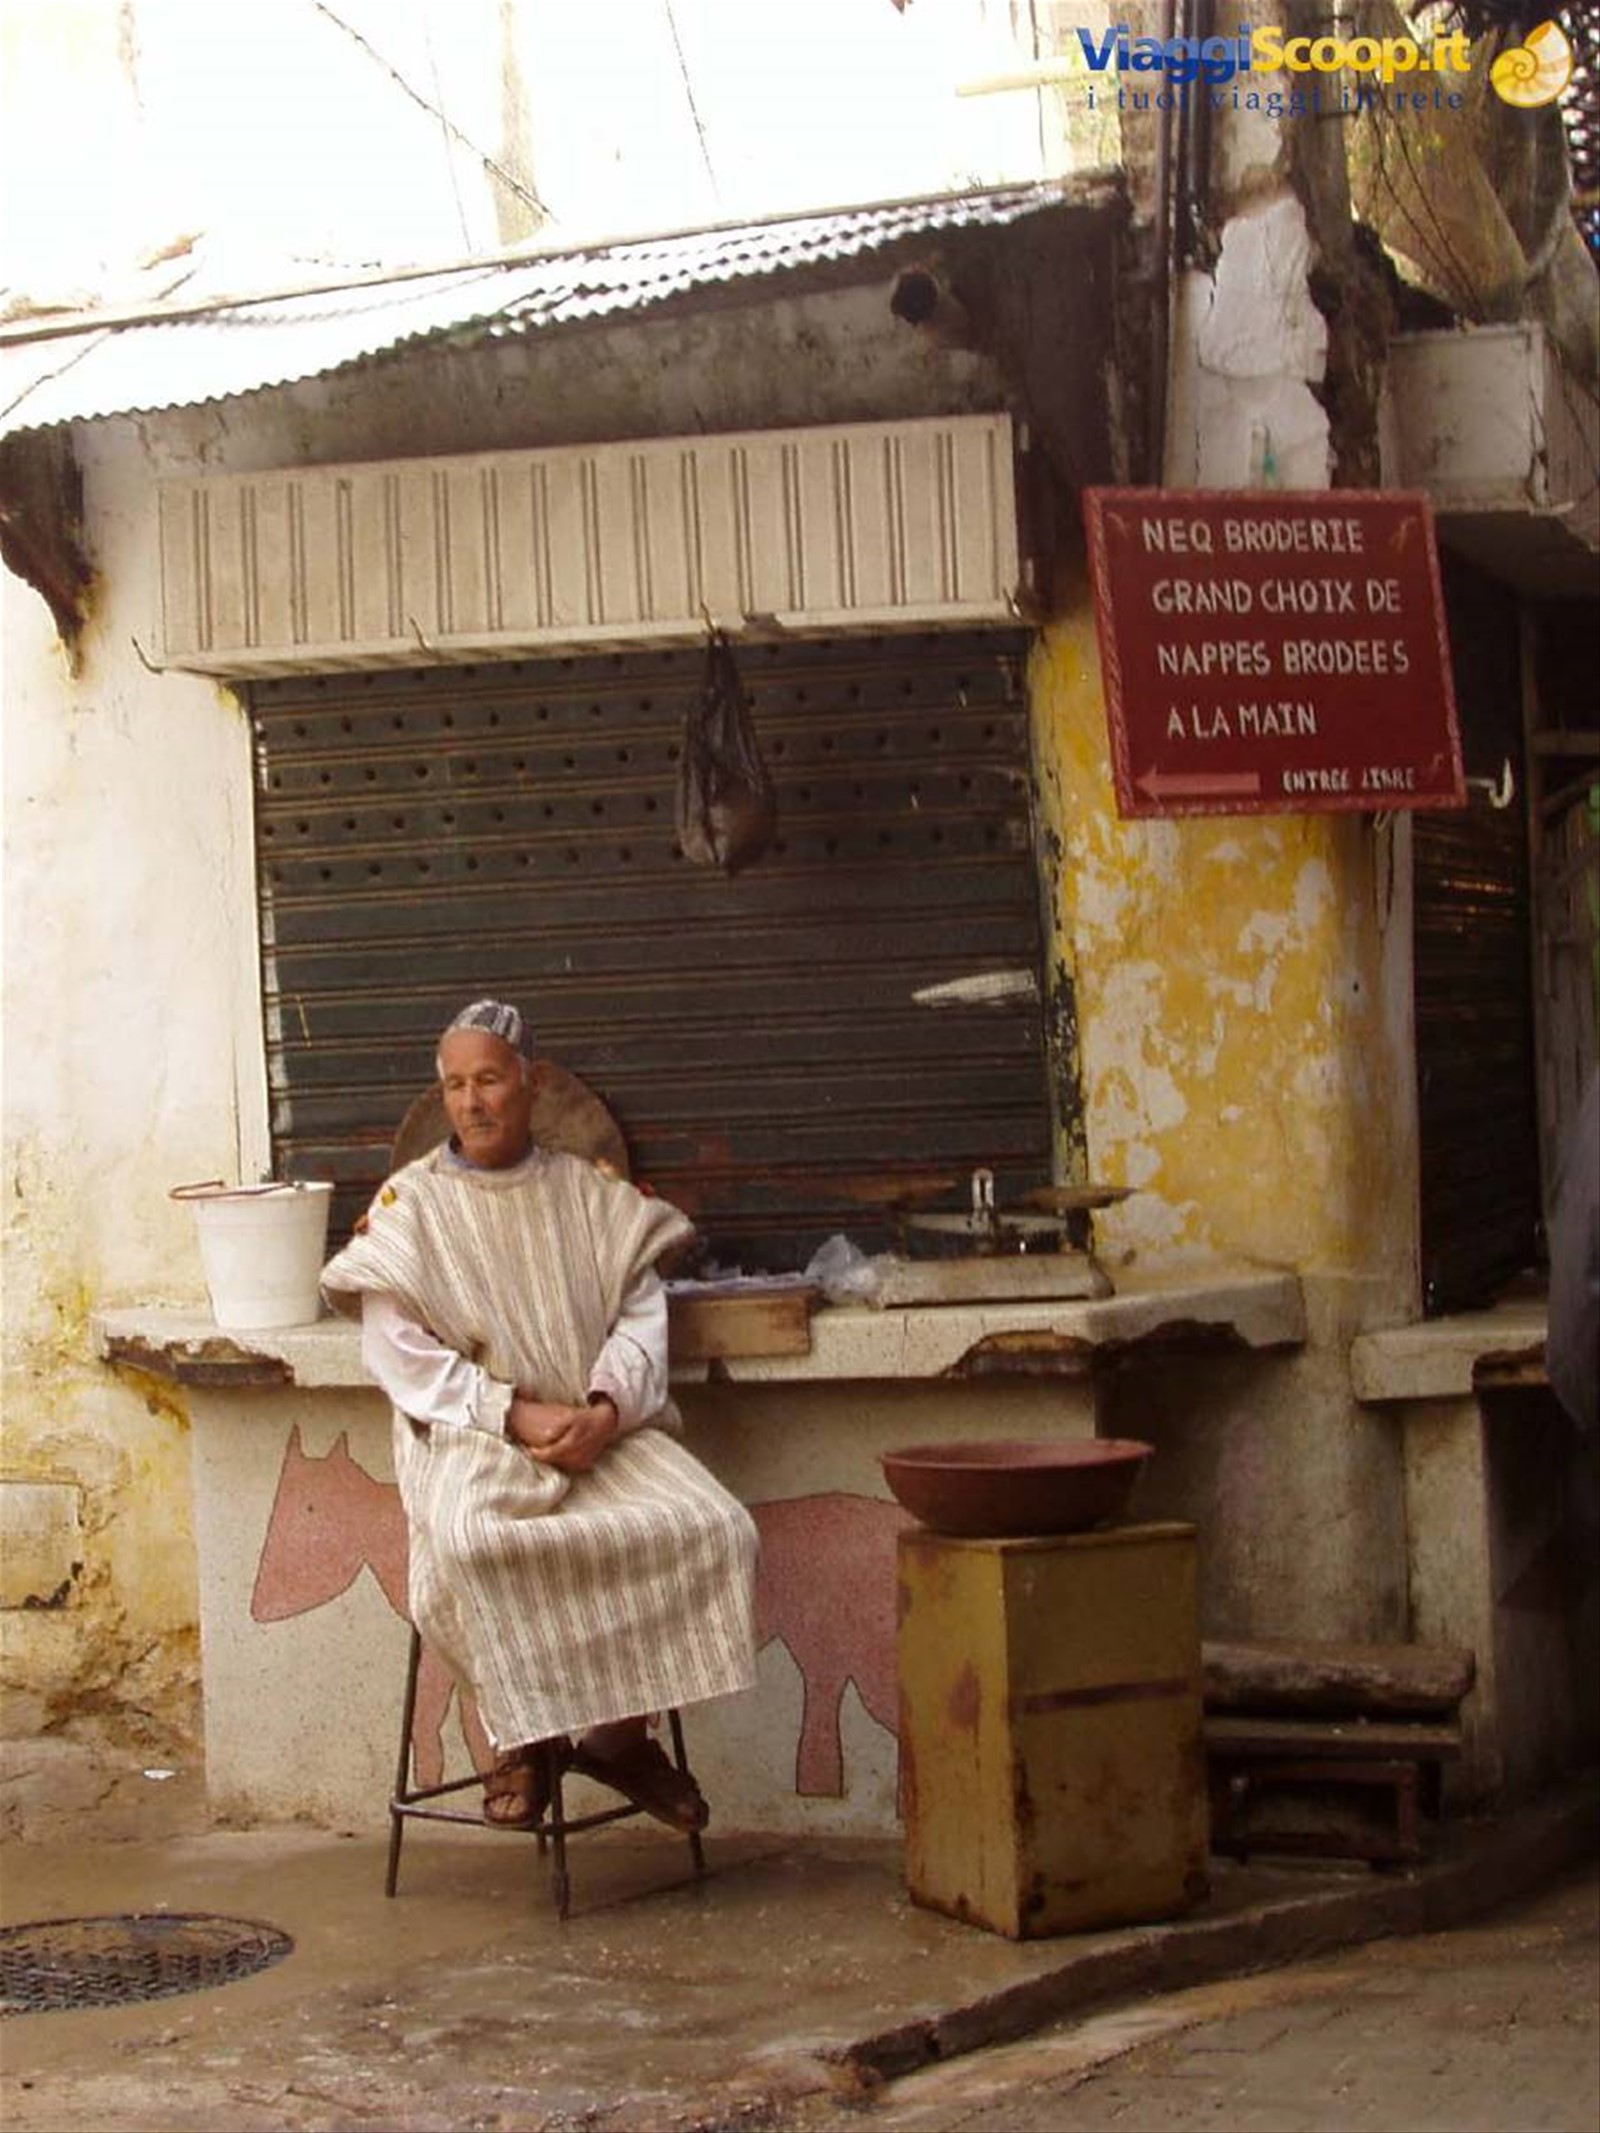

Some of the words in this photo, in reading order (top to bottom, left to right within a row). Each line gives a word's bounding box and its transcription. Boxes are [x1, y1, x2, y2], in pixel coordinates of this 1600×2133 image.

[1225, 518, 1364, 553] BRODERIE
[1152, 580, 1252, 613] GRAND
[1260, 580, 1355, 613] CHOIX
[1366, 580, 1400, 613] DE
[1158, 641, 1271, 675] NAPPES
[1283, 640, 1409, 674] BRODEES
[1168, 707, 1186, 738] A
[1192, 705, 1231, 738] LA
[1239, 703, 1317, 736] MAIN
[1283, 768, 1350, 793] ENTREE
